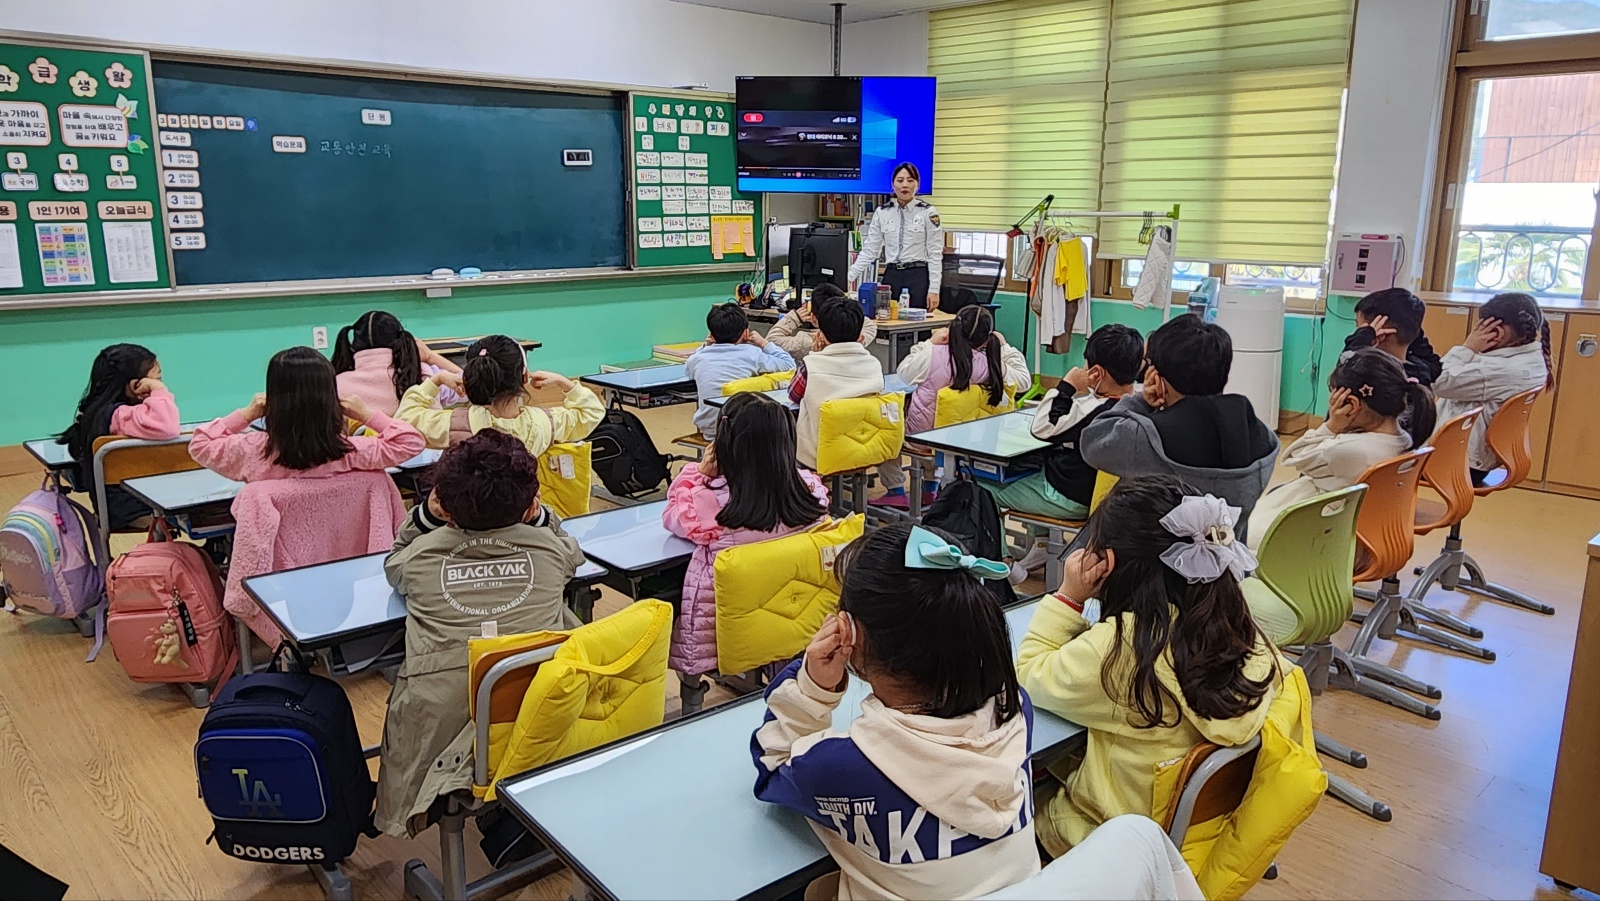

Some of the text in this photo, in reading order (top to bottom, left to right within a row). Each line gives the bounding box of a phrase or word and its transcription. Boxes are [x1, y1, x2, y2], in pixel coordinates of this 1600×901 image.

[10, 109, 39, 118] 가까이
[97, 122, 124, 131] 배우고
[22, 130, 47, 138] 지켜요
[90, 132, 117, 141] 키워요
[13, 156, 21, 165] 3
[65, 158, 72, 166] 4
[168, 153, 173, 163] 1
[116, 160, 123, 168] 5
[19, 177, 34, 186] 국어
[69, 178, 85, 187] 수학
[167, 173, 176, 184] 2
[170, 195, 179, 205] 3
[36, 205, 81, 216] 1인 1기여
[105, 205, 147, 215] 오늘급식
[172, 214, 180, 224] 4
[174, 236, 182, 246] 5
[469, 538, 477, 547] IN
[479, 537, 493, 545] THE
[442, 583, 534, 615] INTERNATIONAL ORGANIZATION
[816, 800, 878, 816] YOUTH DIV.
[232, 843, 325, 861] DODGERS
